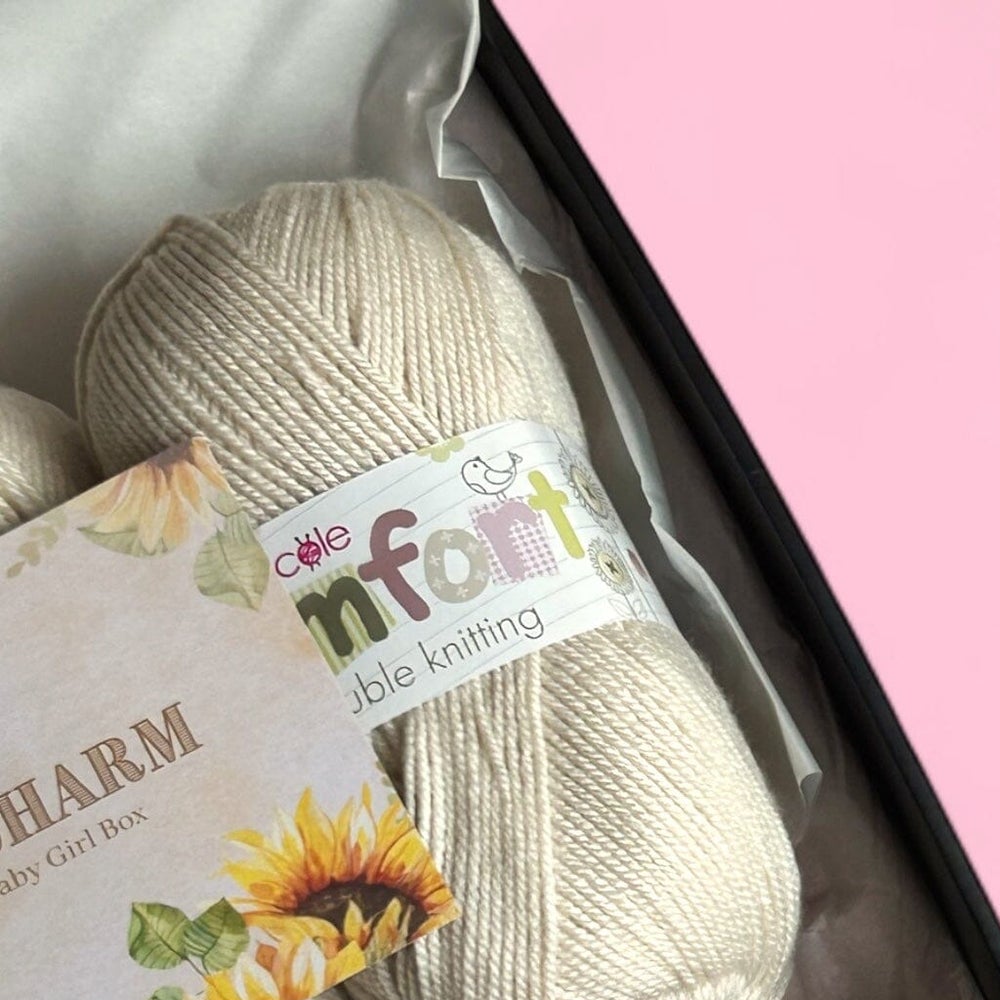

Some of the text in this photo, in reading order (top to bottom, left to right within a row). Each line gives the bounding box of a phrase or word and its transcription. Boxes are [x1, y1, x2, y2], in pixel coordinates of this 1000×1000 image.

[296, 470, 586, 657] mfort
[352, 607, 544, 714] uble knitting
[0, 701, 204, 851] HARM
[0, 807, 150, 895] aby Girl Box
